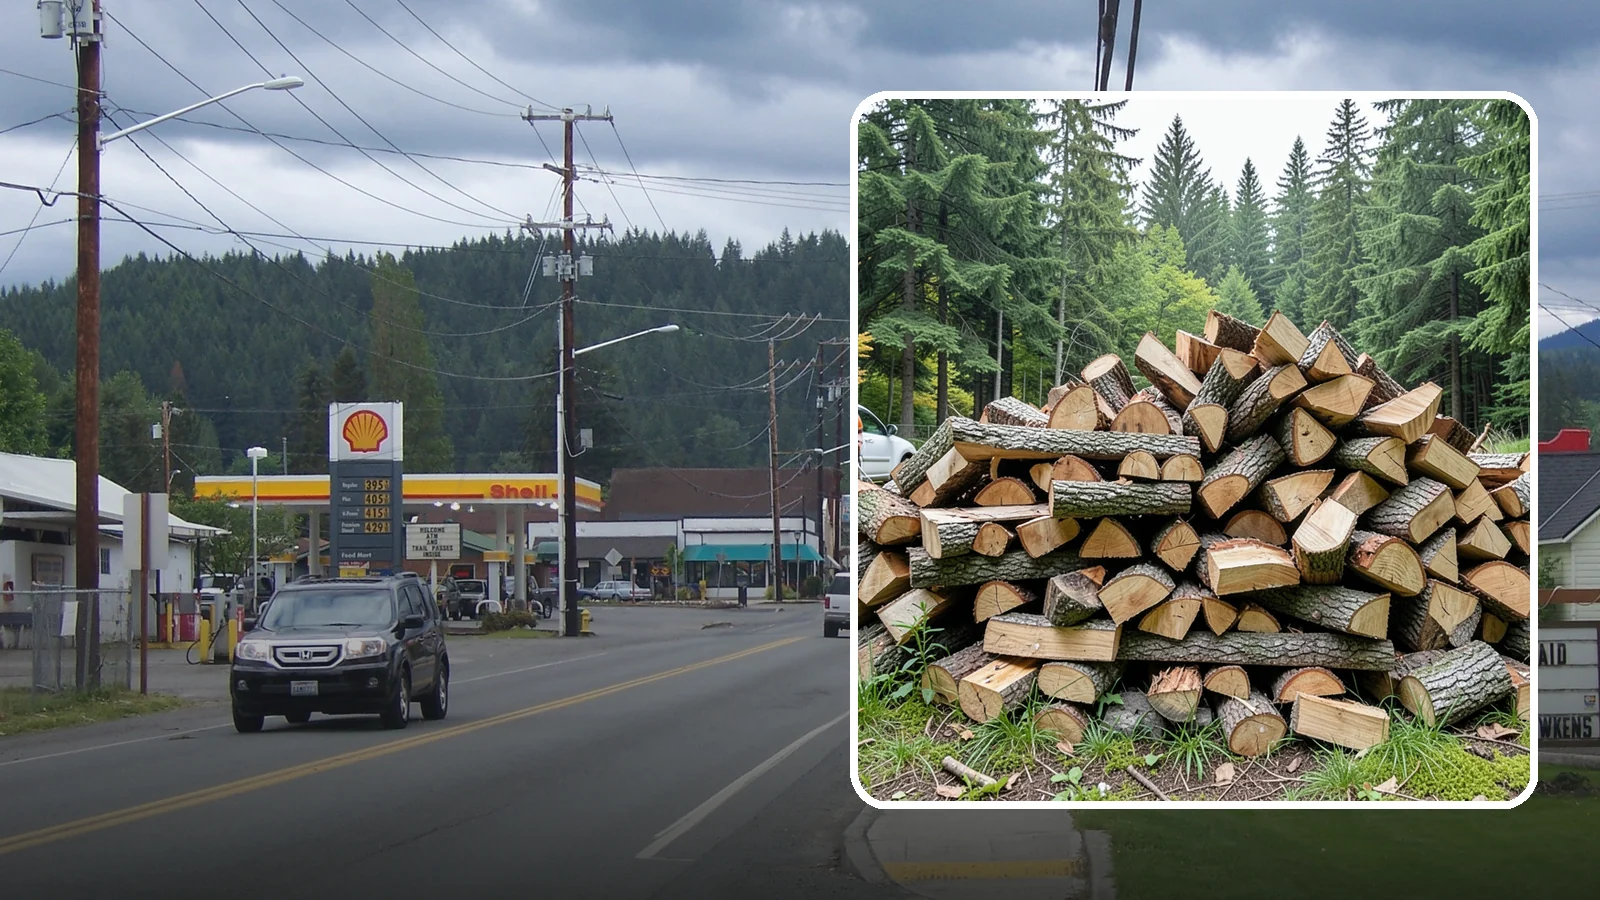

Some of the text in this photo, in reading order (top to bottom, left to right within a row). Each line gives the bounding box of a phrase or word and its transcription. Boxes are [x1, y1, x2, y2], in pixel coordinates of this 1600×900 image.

[365, 480, 383, 490] 395
[490, 484, 547, 499] Shell
[365, 494, 383, 504] 405
[365, 508, 383, 518] 415
[365, 522, 383, 532] 429
[1538, 643, 1567, 666] AID
